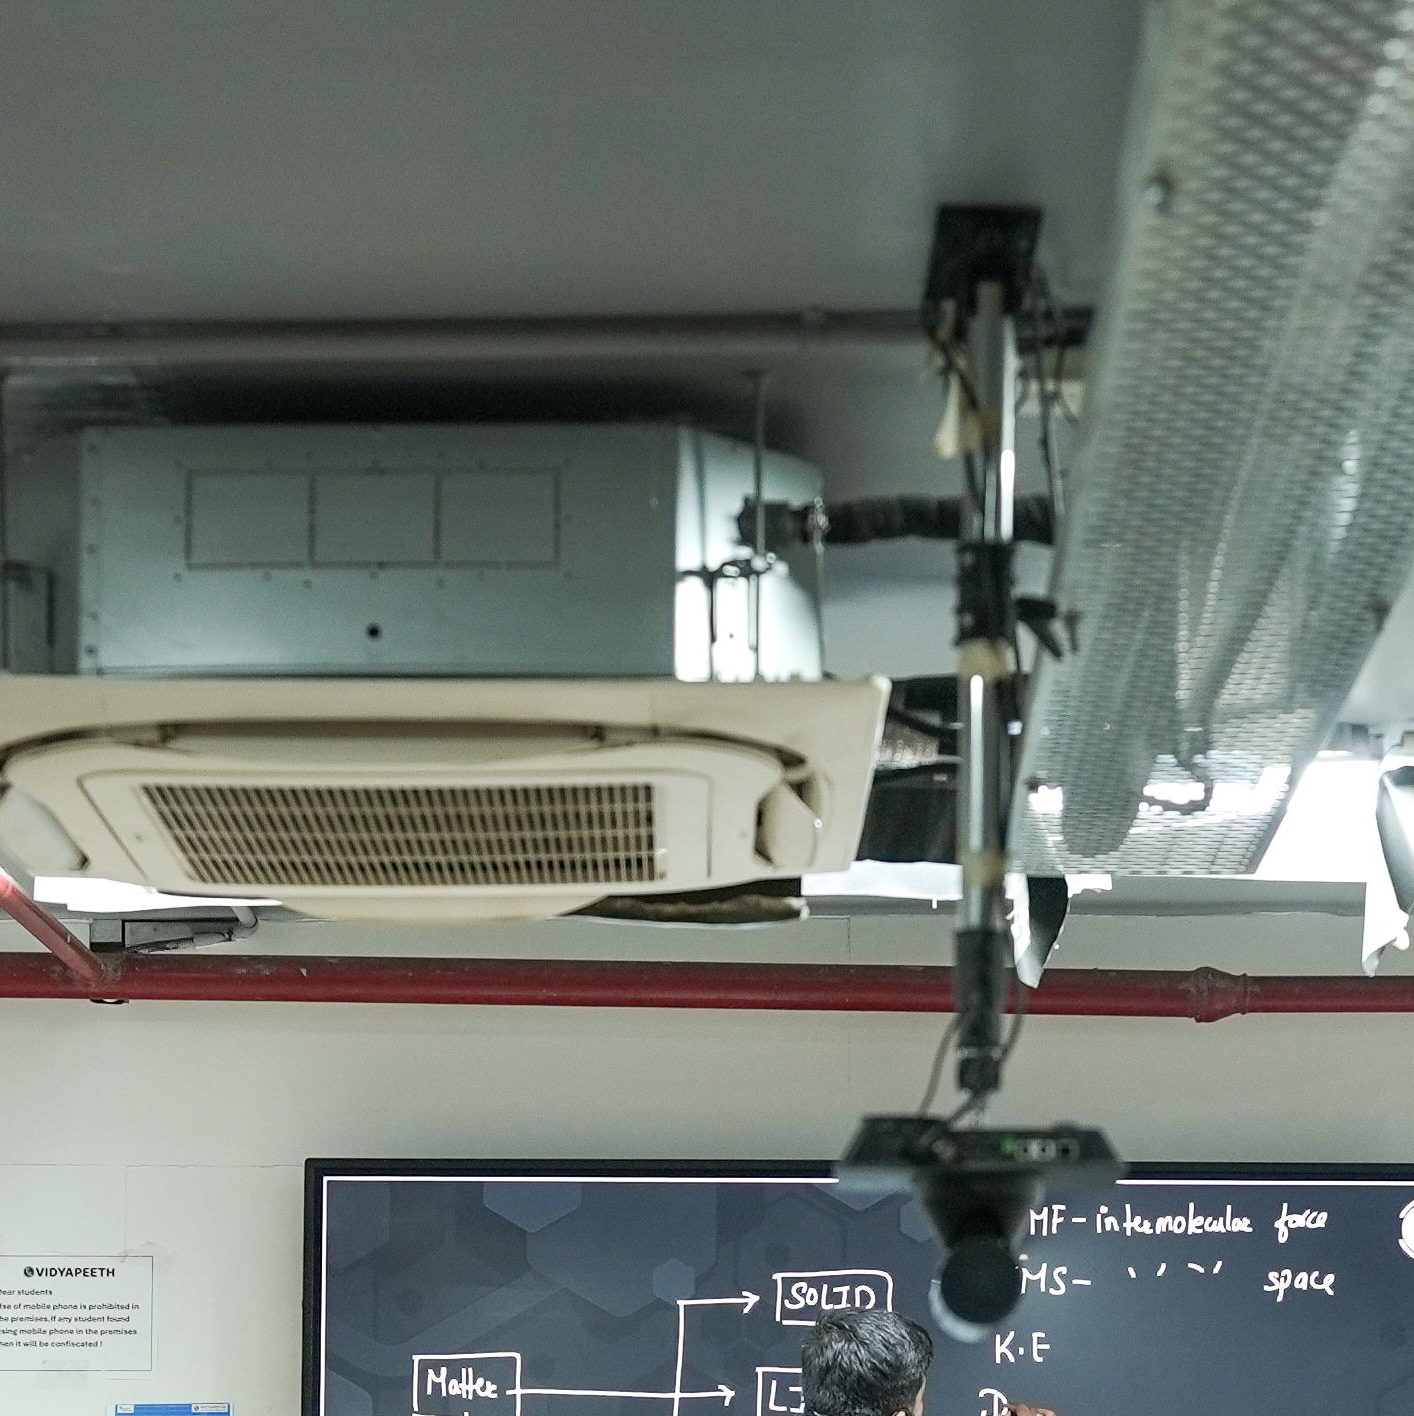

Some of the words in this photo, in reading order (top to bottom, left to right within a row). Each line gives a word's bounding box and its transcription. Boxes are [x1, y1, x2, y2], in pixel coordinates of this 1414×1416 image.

[36, 1267, 115, 1277] VIDYAPEETH
[1263, 1269, 1336, 1302] space
[17, 1288, 53, 1296] students
[785, 1282, 876, 1310] SOLID
[52, 1303, 78, 1312] phone
[88, 1303, 130, 1312] prohibited
[57, 1316, 72, 1324] any
[73, 1315, 105, 1323] student
[106, 1315, 130, 1323] found
[48, 1328, 74, 1336] phone
[100, 1328, 137, 1336] premises
[39, 1340, 49, 1348] be
[50, 1340, 98, 1348] confiscated
